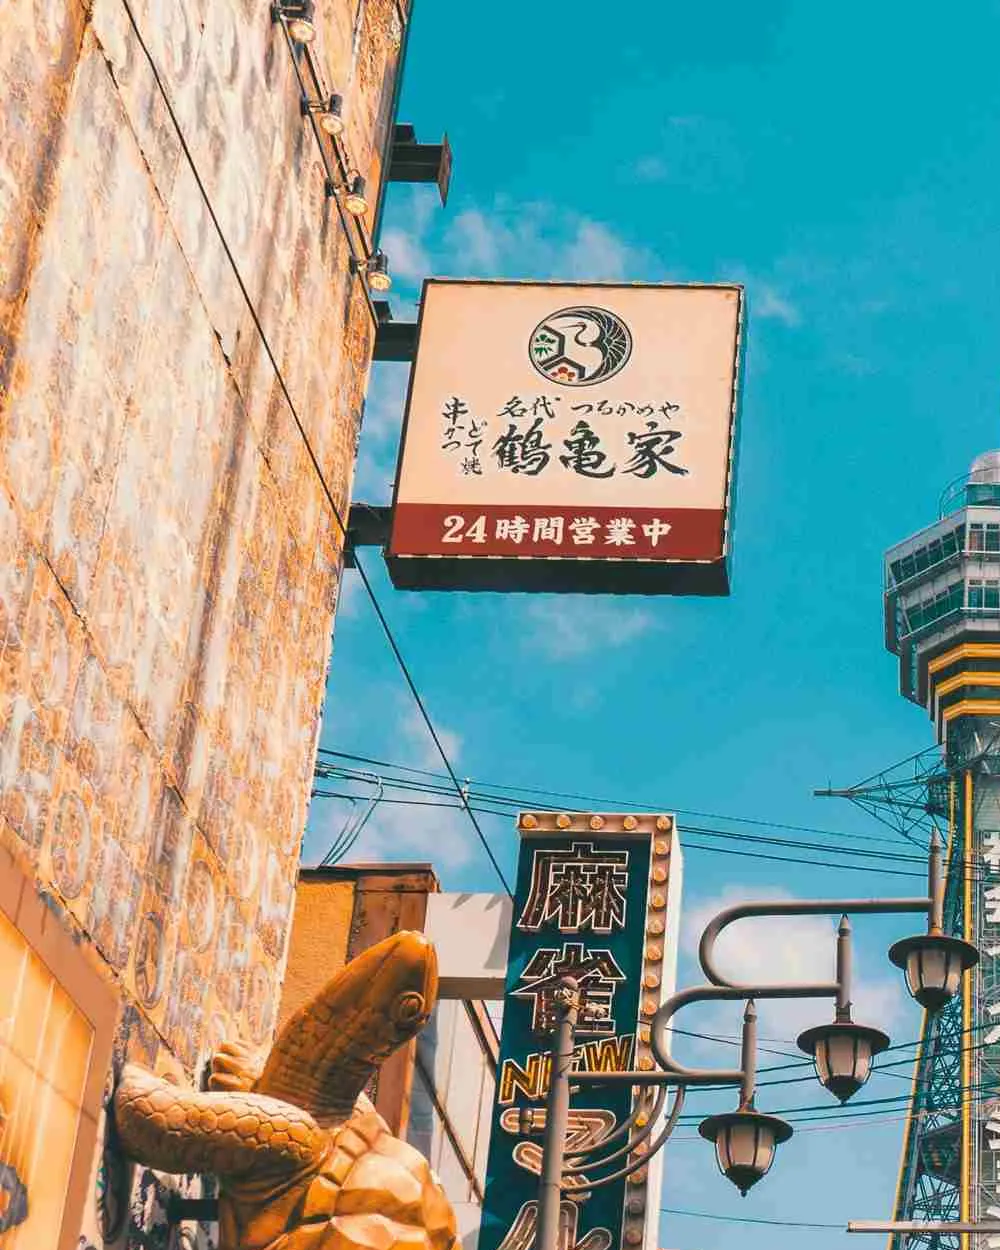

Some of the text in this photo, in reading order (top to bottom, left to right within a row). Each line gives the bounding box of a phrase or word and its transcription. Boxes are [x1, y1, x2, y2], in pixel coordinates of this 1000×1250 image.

[441, 396, 468, 452] 串かつ
[497, 396, 680, 419] 名代 つるかめや
[460, 418, 489, 475] どて焼
[493, 418, 689, 479] 鶴亀家
[441, 514, 672, 548] 24時間営業中
[510, 842, 628, 1035] 麻雀
[499, 1033, 636, 1105] NEW
